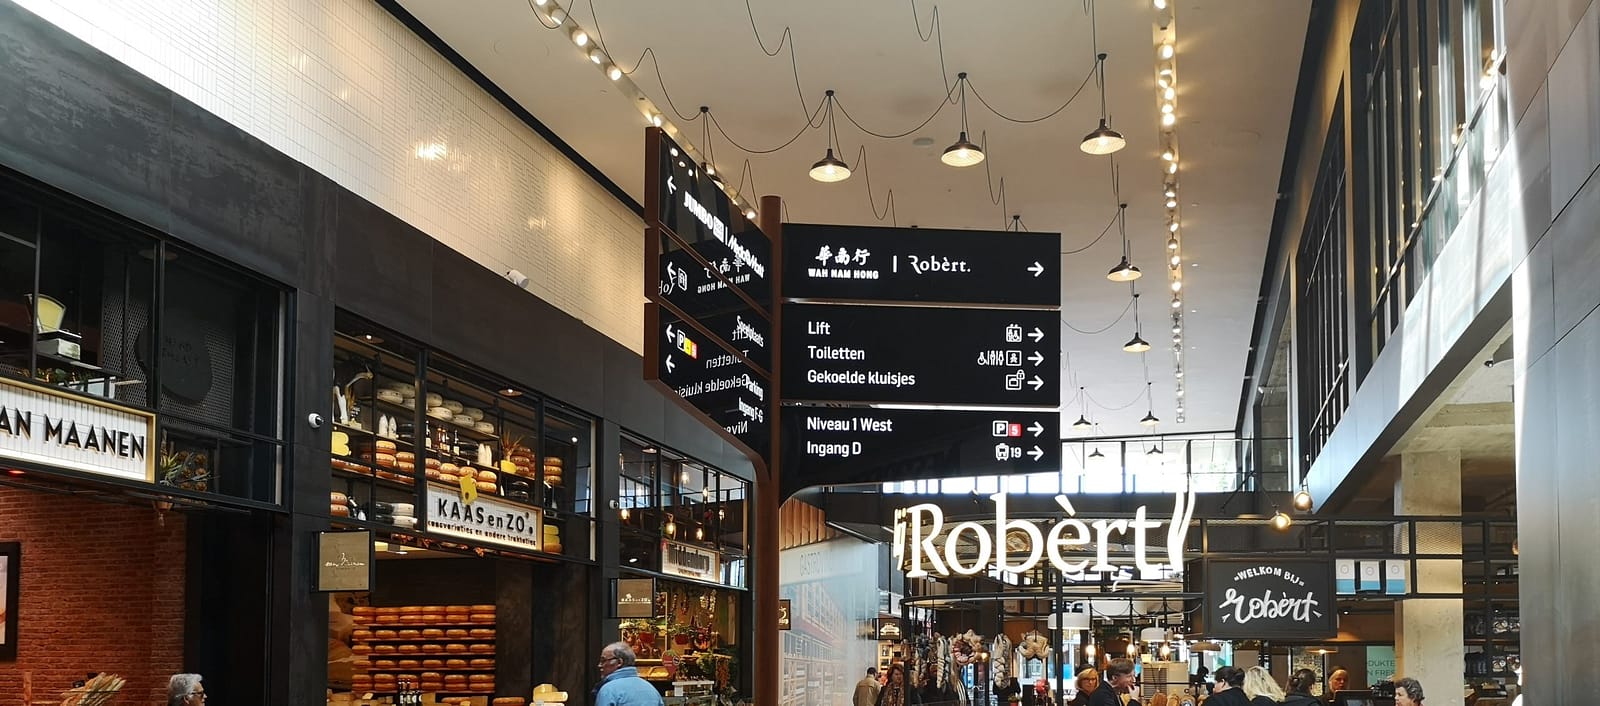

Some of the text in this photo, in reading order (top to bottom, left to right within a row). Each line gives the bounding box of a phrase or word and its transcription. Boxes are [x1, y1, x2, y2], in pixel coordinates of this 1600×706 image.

[683, 191, 713, 230] JUMBO
[807, 268, 879, 280] WAH NAM HONG
[808, 321, 830, 335] Lift
[807, 346, 865, 360] Toiletten
[807, 369, 916, 388] Gekoelde kluisjes
[807, 417, 892, 432] Niveau 1 West
[43, 413, 145, 460] MAANEN
[807, 441, 862, 458] Ingang D
[1010, 447, 1022, 458] 19
[905, 489, 1164, 578] Robèrt
[1237, 566, 1300, 584] WELKOM BIJ
